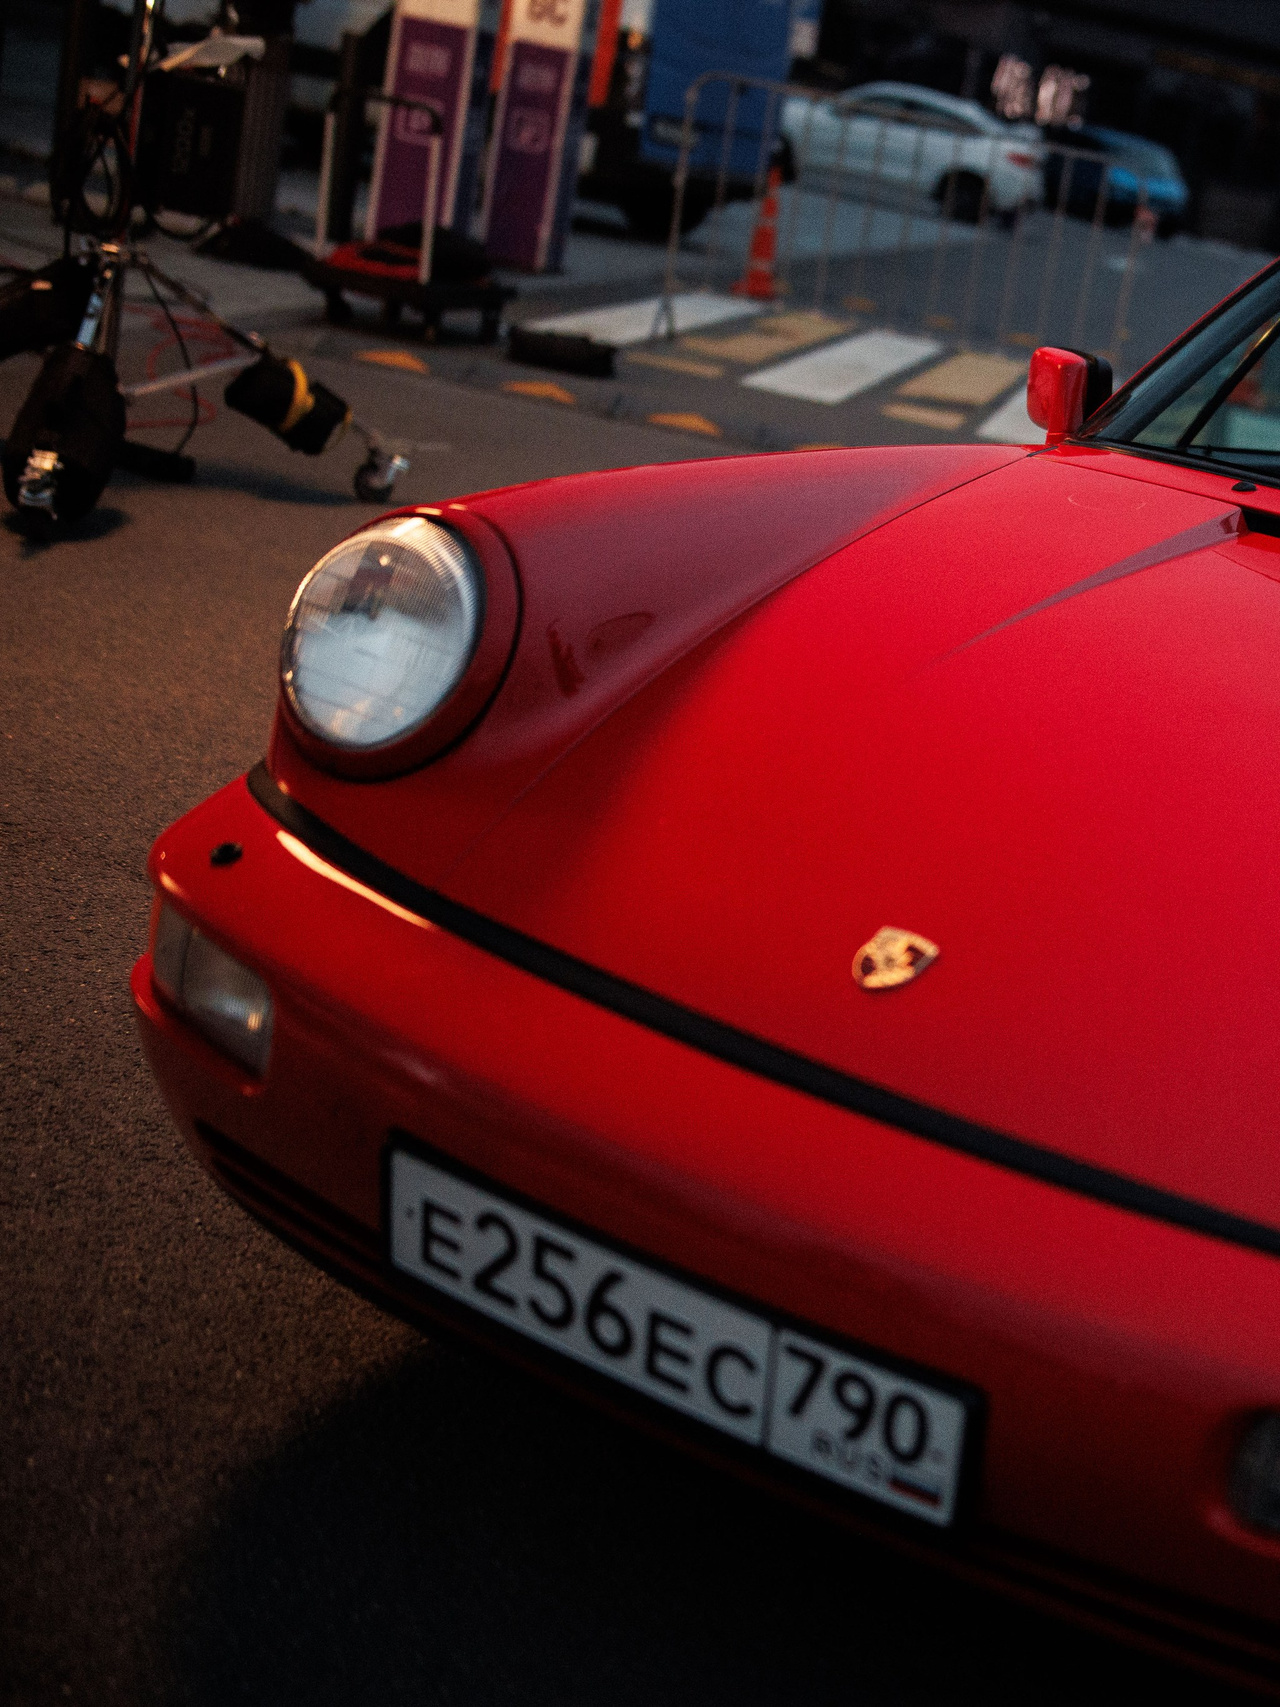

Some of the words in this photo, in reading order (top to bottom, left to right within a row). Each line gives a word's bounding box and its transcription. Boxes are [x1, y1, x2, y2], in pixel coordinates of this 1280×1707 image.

[422, 1201, 756, 1417] E256EC
[785, 1344, 927, 1464] 790
[812, 1430, 884, 1480] RUS
